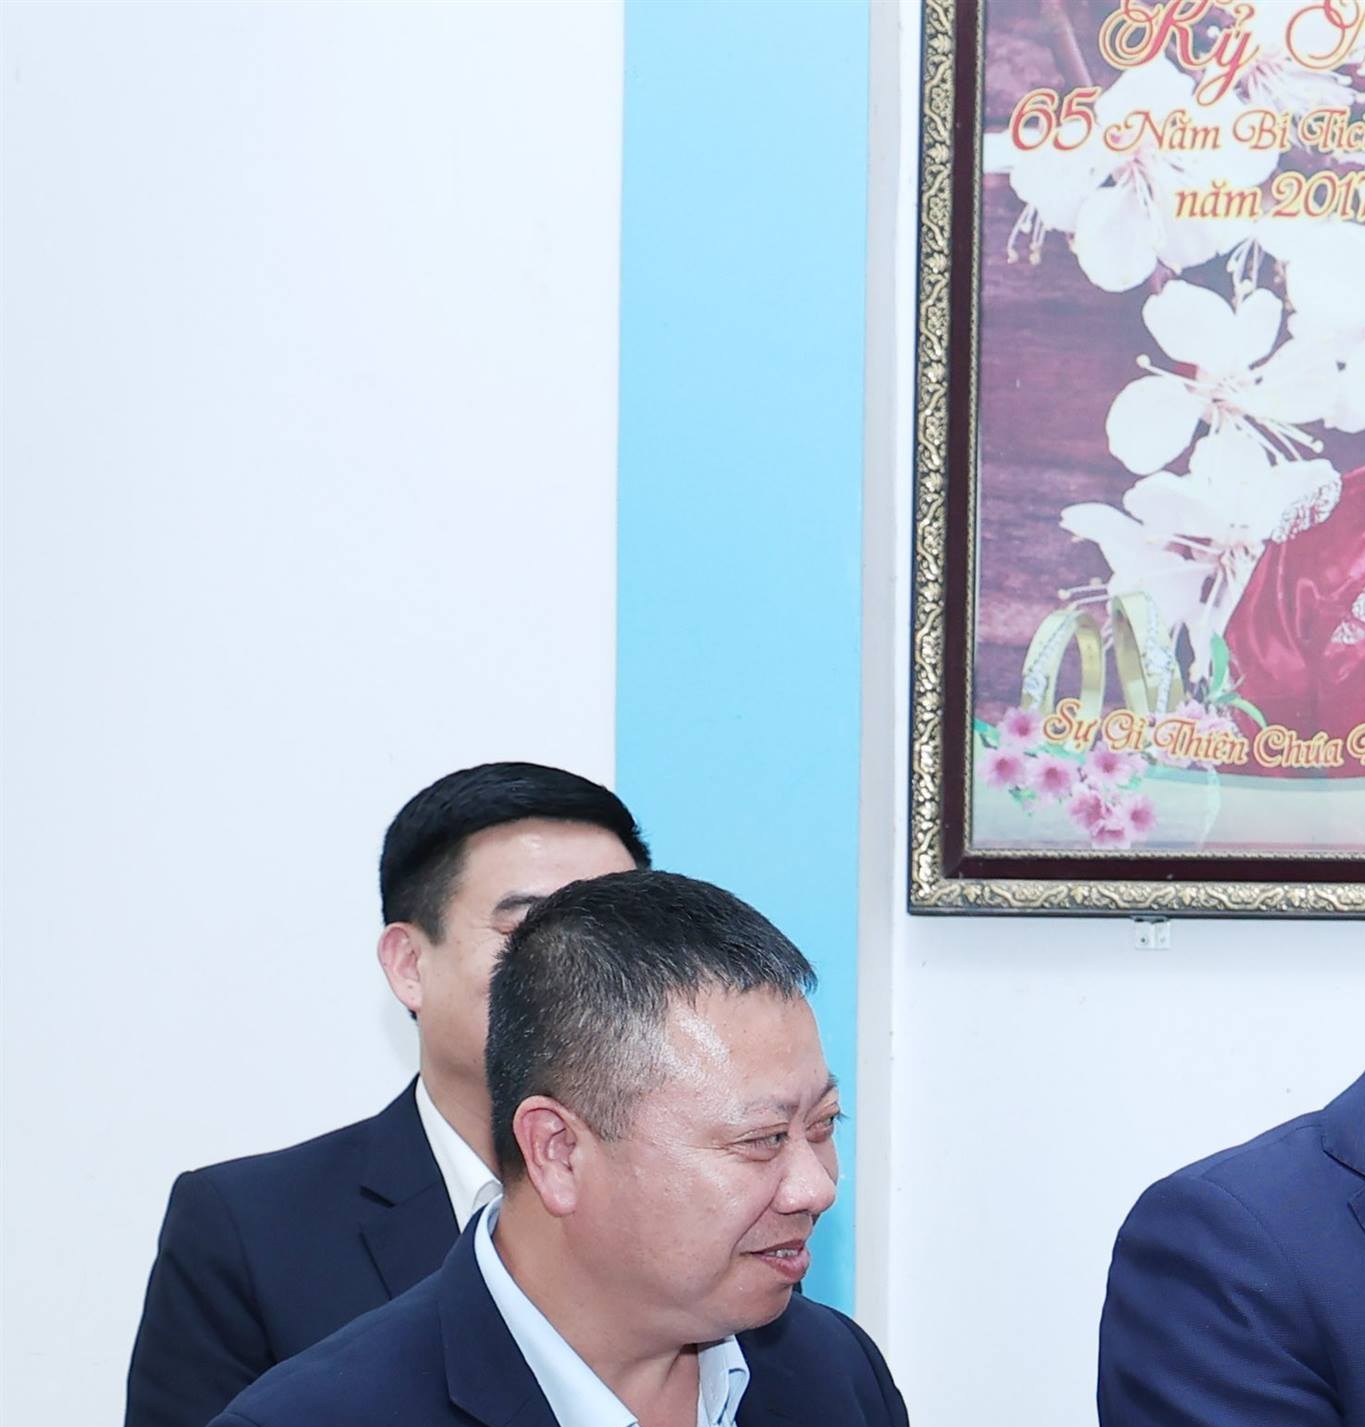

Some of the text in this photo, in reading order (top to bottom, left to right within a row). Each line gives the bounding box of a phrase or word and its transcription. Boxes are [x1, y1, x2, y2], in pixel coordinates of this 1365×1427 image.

[1009, 88, 1101, 152] 65
[1103, 108, 1221, 152] Năm
[1175, 178, 1261, 219] năm
[1043, 697, 1098, 752] Sự
[1152, 716, 1248, 765] Thiên
[1253, 724, 1344, 768] Chúa
